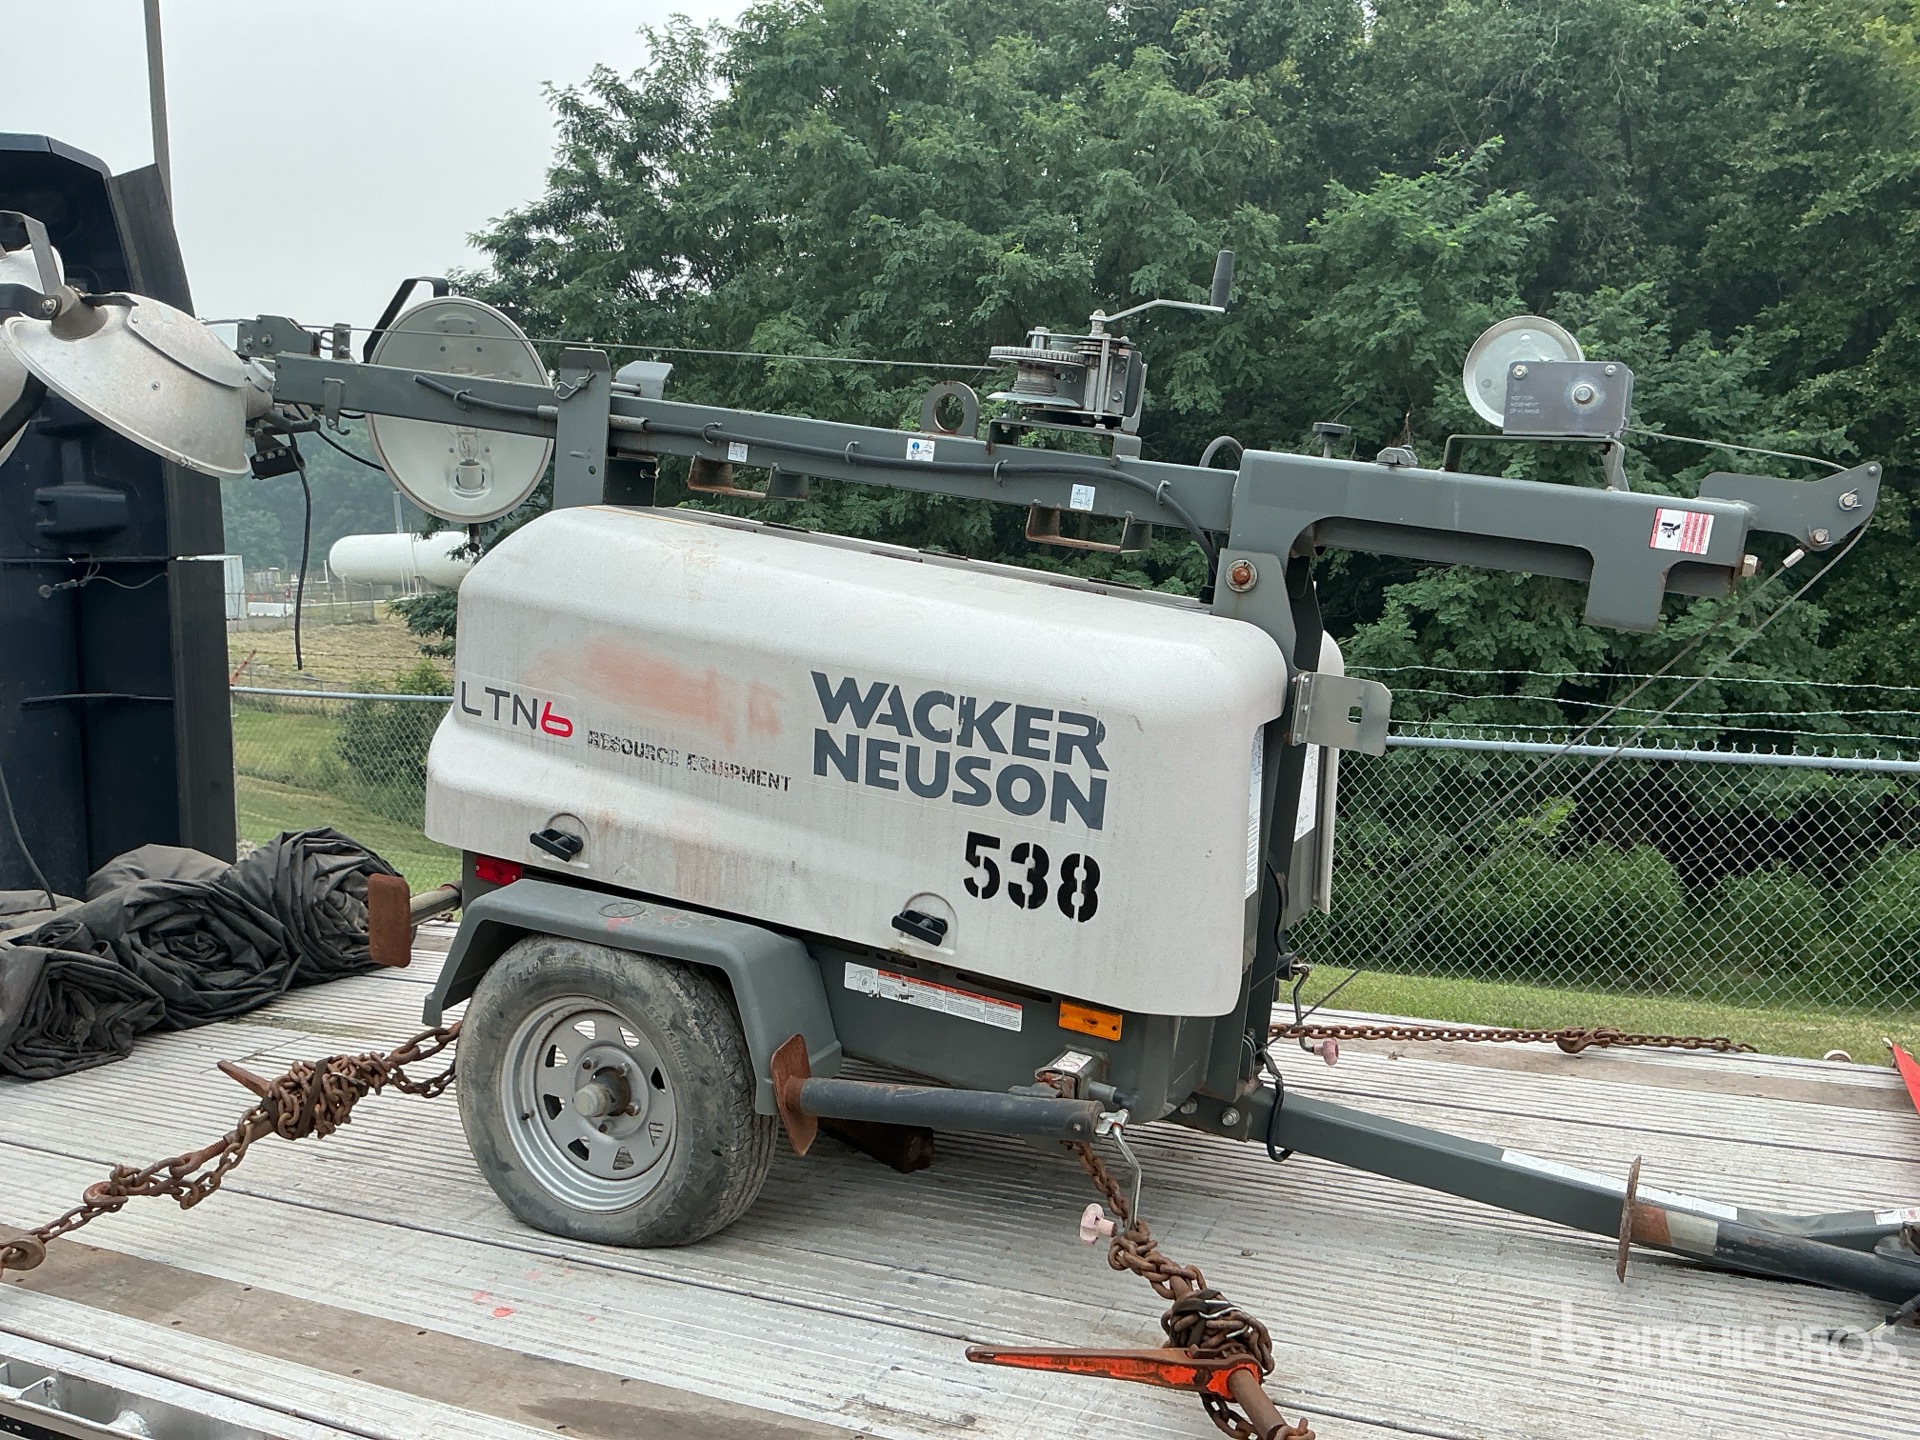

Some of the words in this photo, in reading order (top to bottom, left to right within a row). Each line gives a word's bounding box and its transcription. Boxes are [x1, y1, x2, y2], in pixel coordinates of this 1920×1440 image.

[461, 680, 573, 738] LTN6
[810, 671, 1110, 771] WACKER
[587, 730, 679, 767] RESOURCE
[687, 752, 792, 792] EQUIPMENT
[813, 728, 1108, 831] NEUSON
[963, 831, 1101, 923] 538
